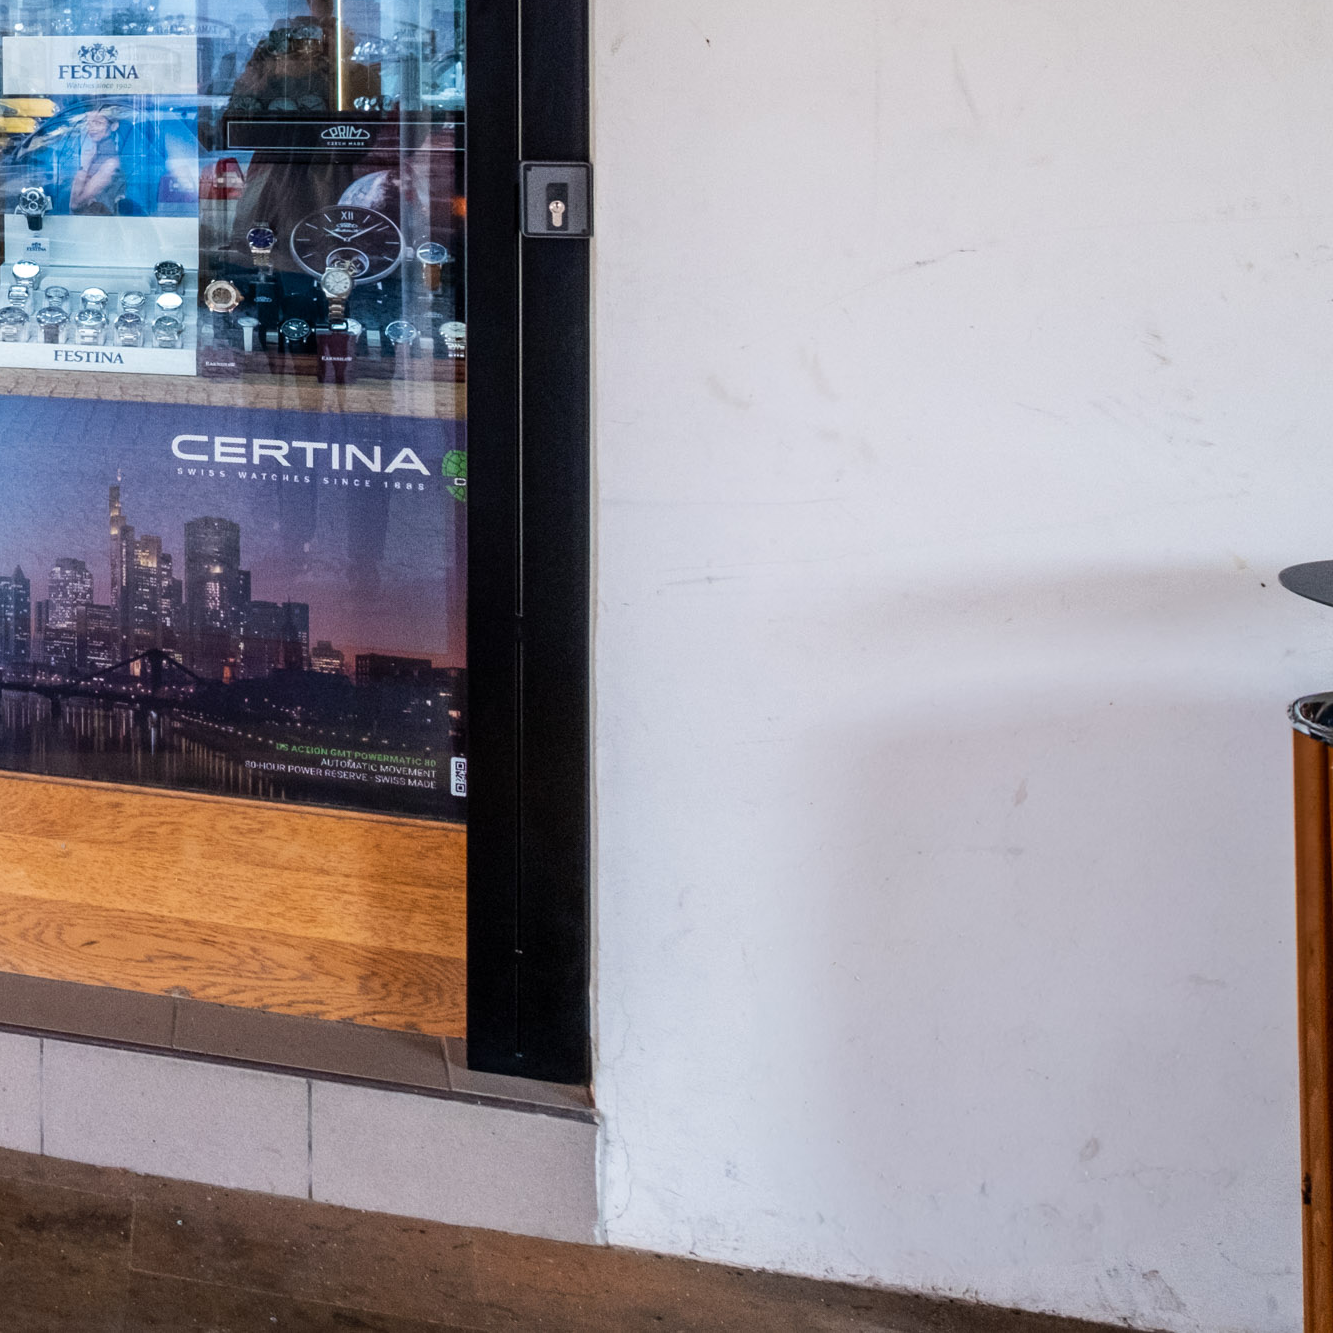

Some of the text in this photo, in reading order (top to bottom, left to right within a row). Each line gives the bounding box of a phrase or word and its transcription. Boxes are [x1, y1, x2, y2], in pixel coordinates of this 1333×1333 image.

[58, 65, 140, 80] FESTINA
[329, 126, 362, 138] PRIM
[341, 211, 354, 220] XII
[53, 350, 124, 364] FESTINA
[171, 434, 431, 476] CERTINA
[177, 468, 425, 491] SWISS WATCHES SINCE 1888
[291, 745, 329, 755] ACTION
[331, 749, 353, 758] GMT
[355, 752, 422, 766] POWERMATIC
[424, 759, 437, 767] 80
[244, 760, 437, 789] 80-HOUR POWER RESERVE SWISS MADE
[321, 758, 437, 778] AUTOMATIC MOVEMENT
